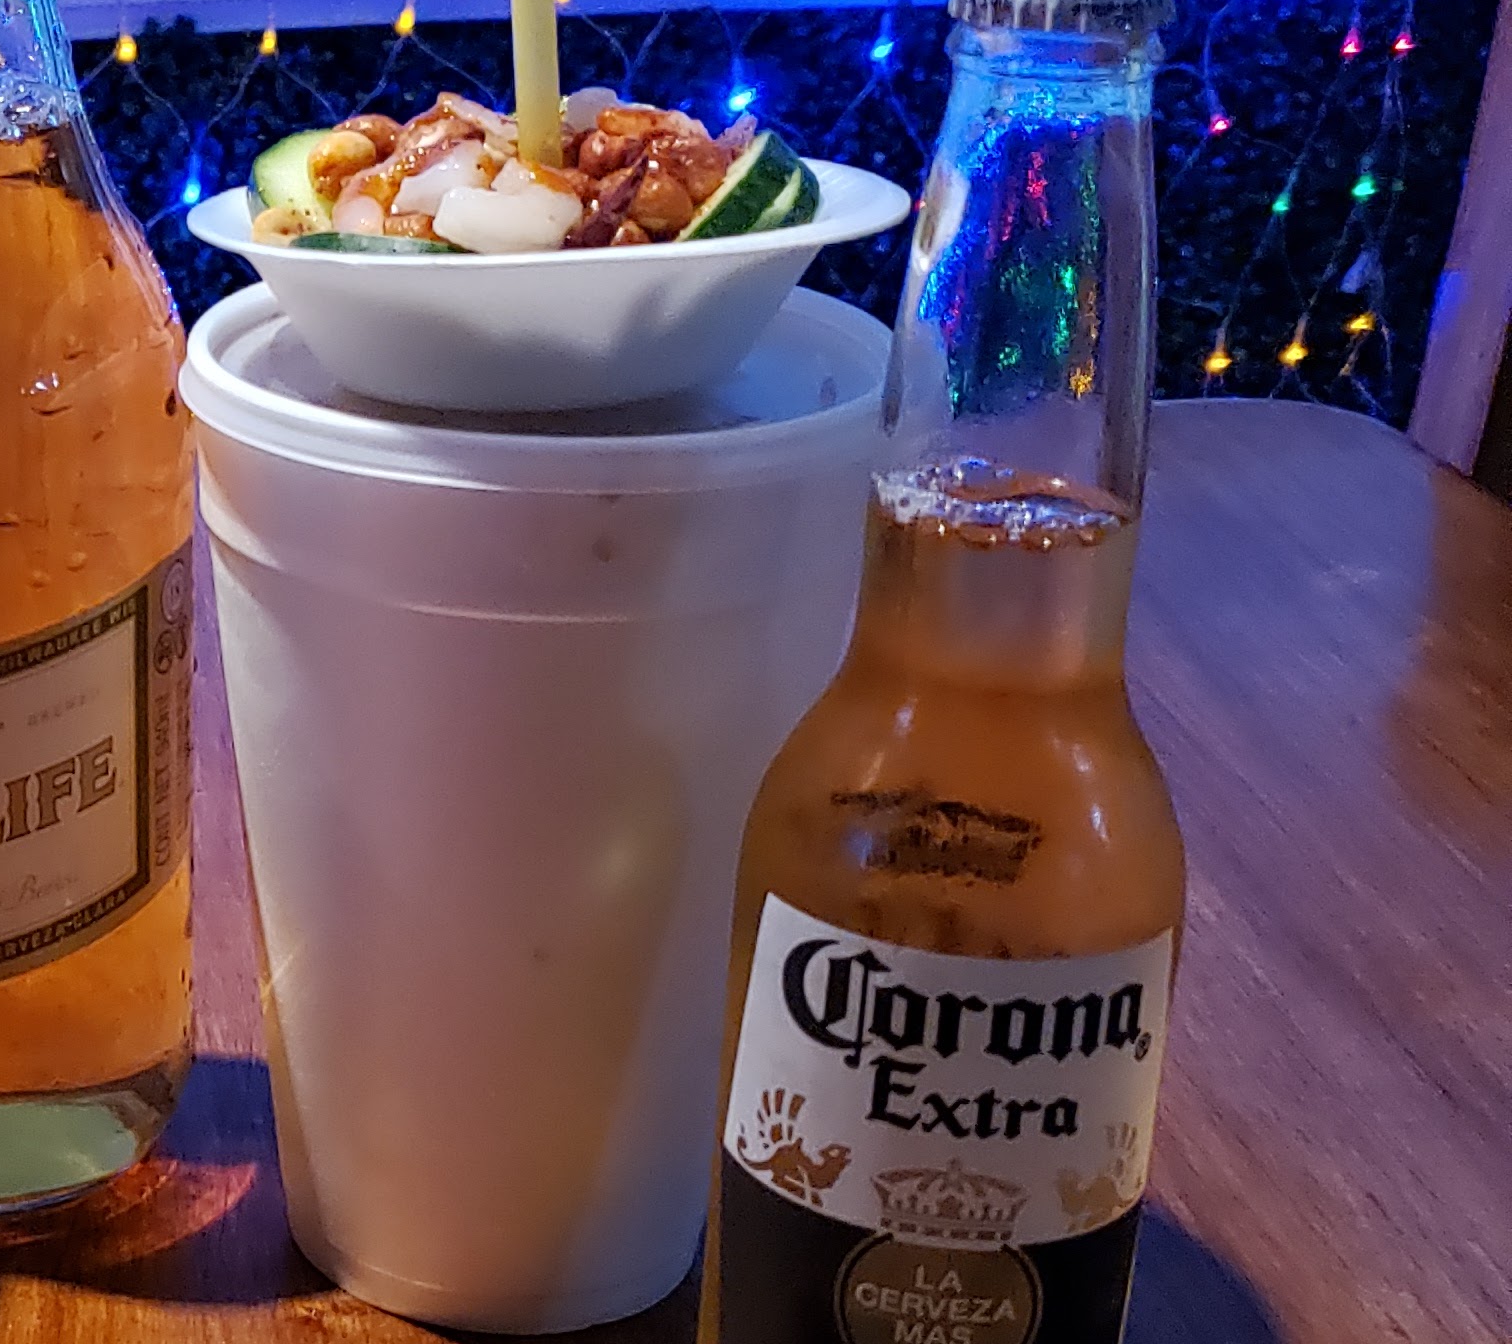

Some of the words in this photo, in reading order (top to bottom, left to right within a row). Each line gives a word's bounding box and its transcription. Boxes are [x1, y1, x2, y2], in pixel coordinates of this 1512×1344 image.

[782, 938, 1143, 1069] Corona
[865, 1055, 1080, 1140] Extra
[855, 1282, 1016, 1322] CERVEZA
[914, 1264, 963, 1293] LA
